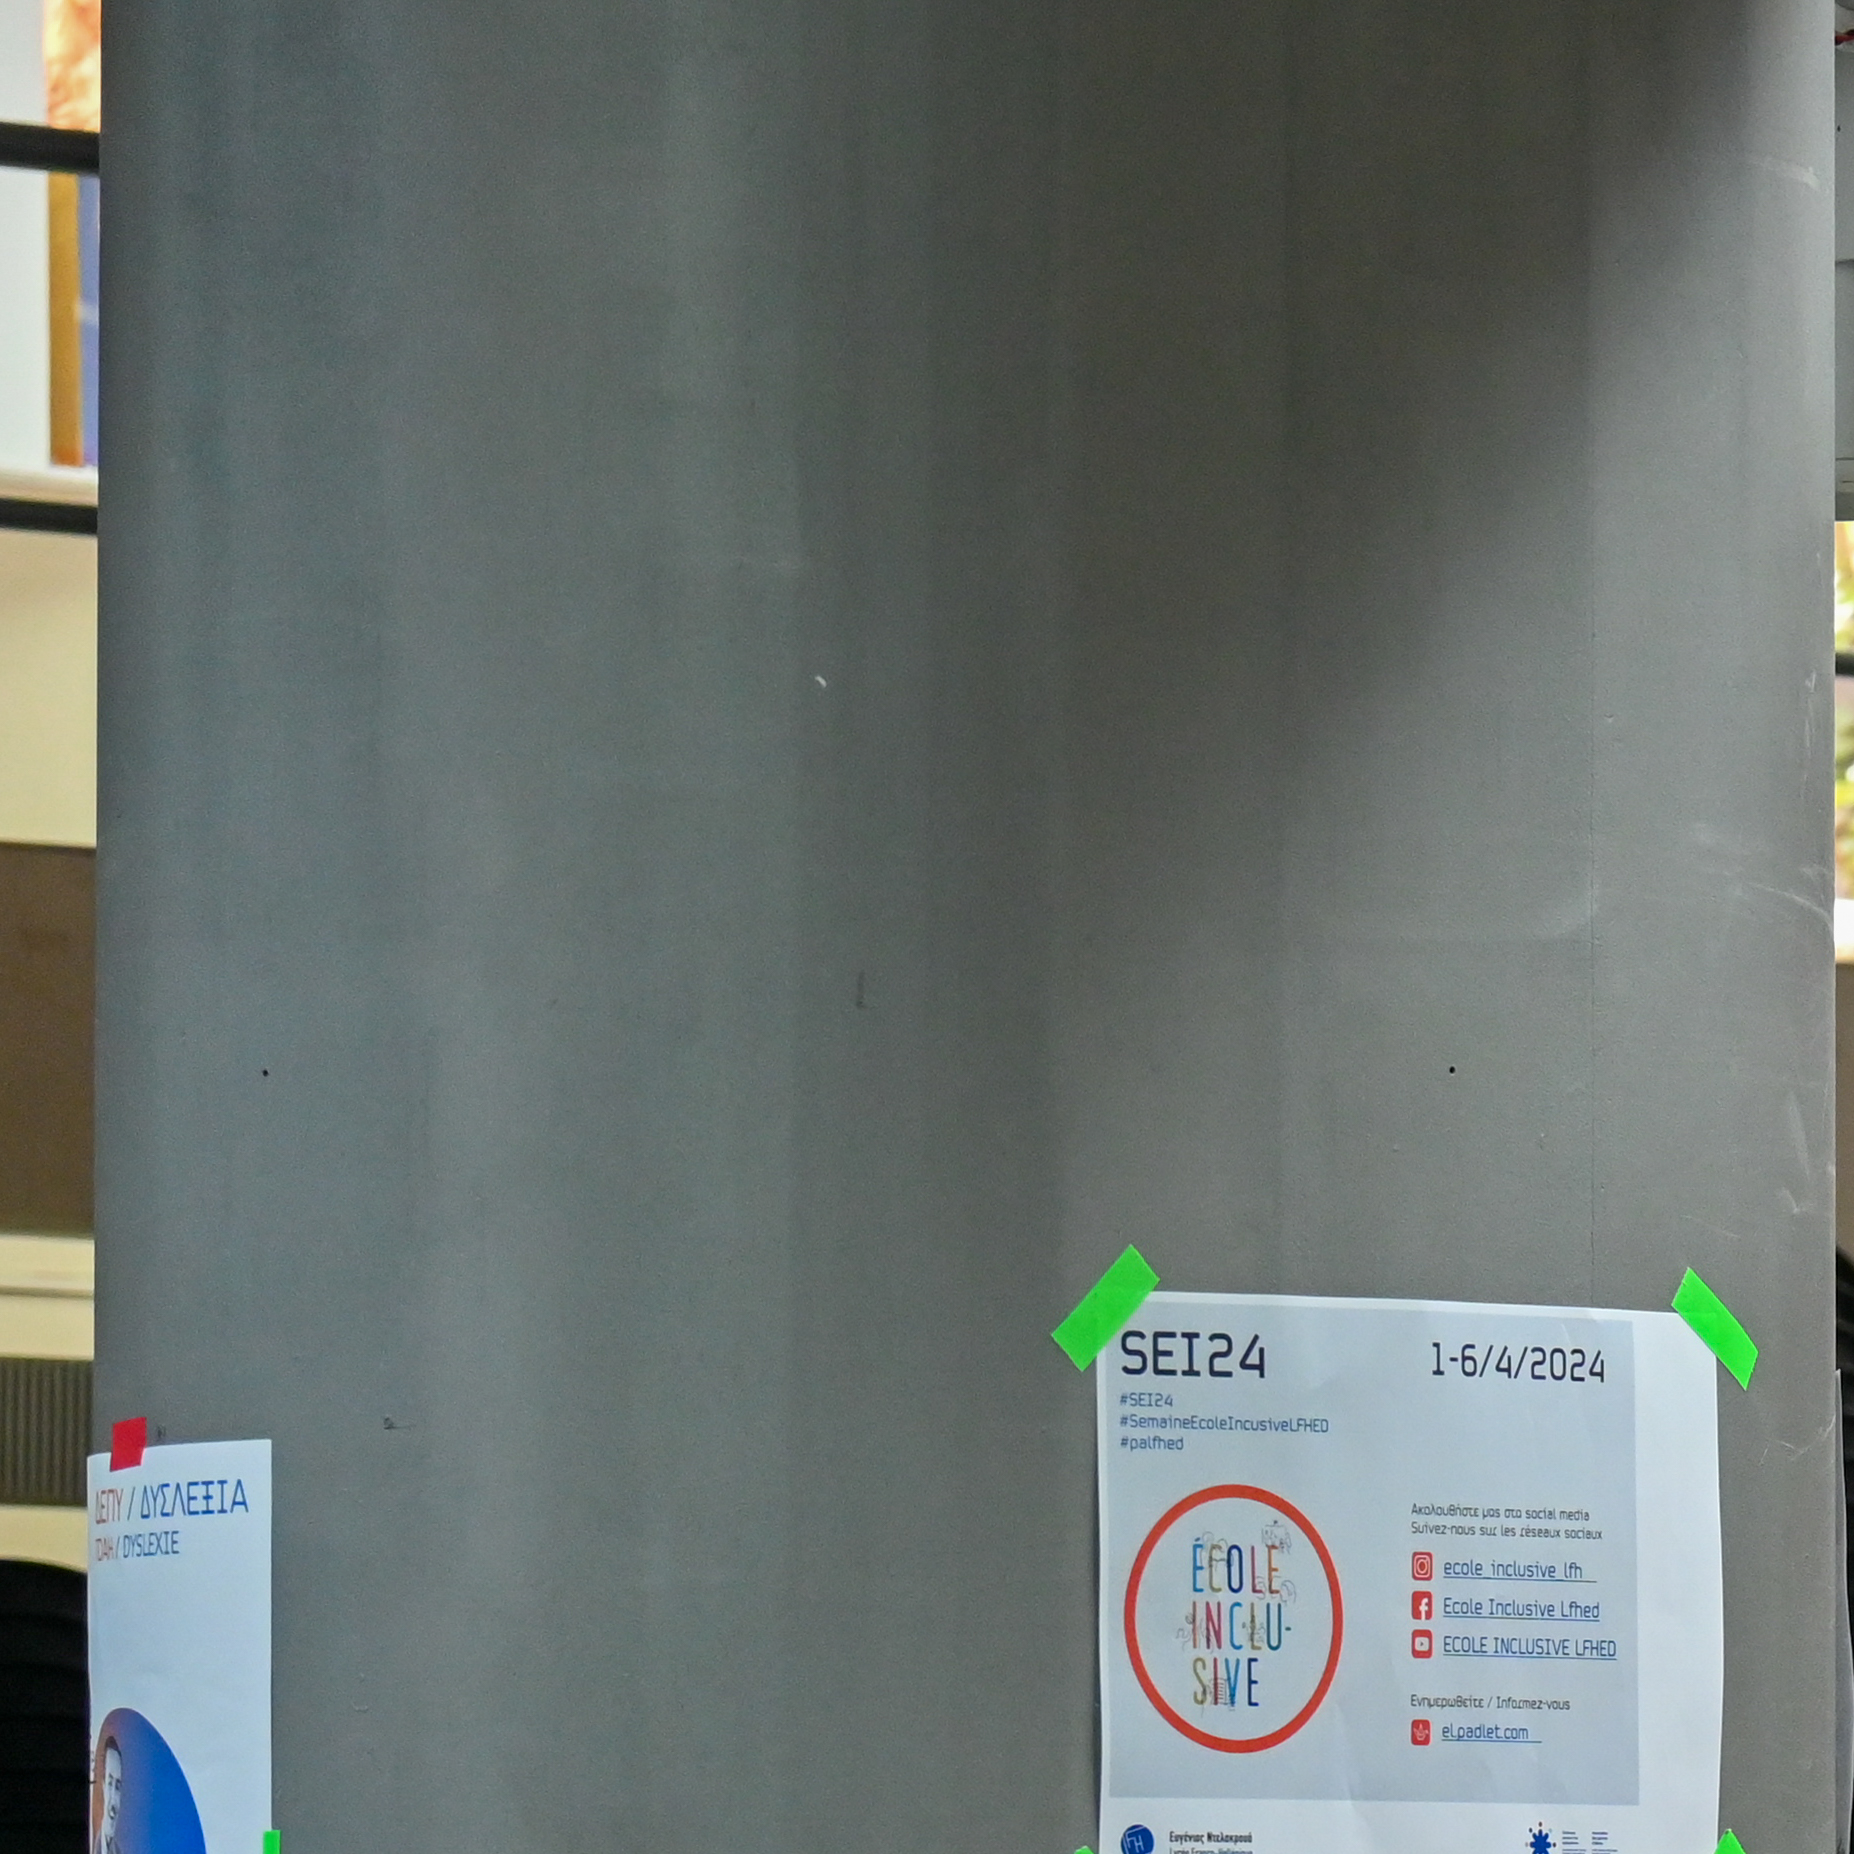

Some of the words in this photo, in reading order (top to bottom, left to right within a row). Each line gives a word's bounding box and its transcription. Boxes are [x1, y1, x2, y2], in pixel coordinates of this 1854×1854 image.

[1120, 1329, 1266, 1379] SEI24
[1431, 1341, 1605, 1384] 1-6/4/2024
[1119, 1391, 1174, 1408] #SEI24
[1119, 1413, 1330, 1434] #SemaineEcoleIncusiveLFHED
[140, 1479, 249, 1519] ΔΥΣΛΕΞΙΑ
[1525, 1507, 1557, 1521] social
[1559, 1509, 1591, 1522] media
[1411, 1521, 1477, 1536] Suivez-nous
[1479, 1524, 1498, 1537] sur
[1500, 1525, 1517, 1538] les
[1519, 1524, 1562, 1538] réseaux
[1564, 1527, 1604, 1540] sociaux
[123, 1531, 180, 1559] DYSLEXIE
[1193, 1537, 1281, 1594] ÉCOLE
[1443, 1597, 1483, 1616] Ecole
[1488, 1598, 1556, 1618] Inclusive
[1561, 1601, 1600, 1619] Lfhed
[1193, 1601, 1292, 1651] INCLU-
[1443, 1636, 1488, 1654] ECOLE
[1493, 1637, 1571, 1656] INCLUSIVE
[1575, 1640, 1617, 1657] LFHED
[1193, 1657, 1260, 1708] SIVE
[1496, 1696, 1571, 1711] Informez-vous
